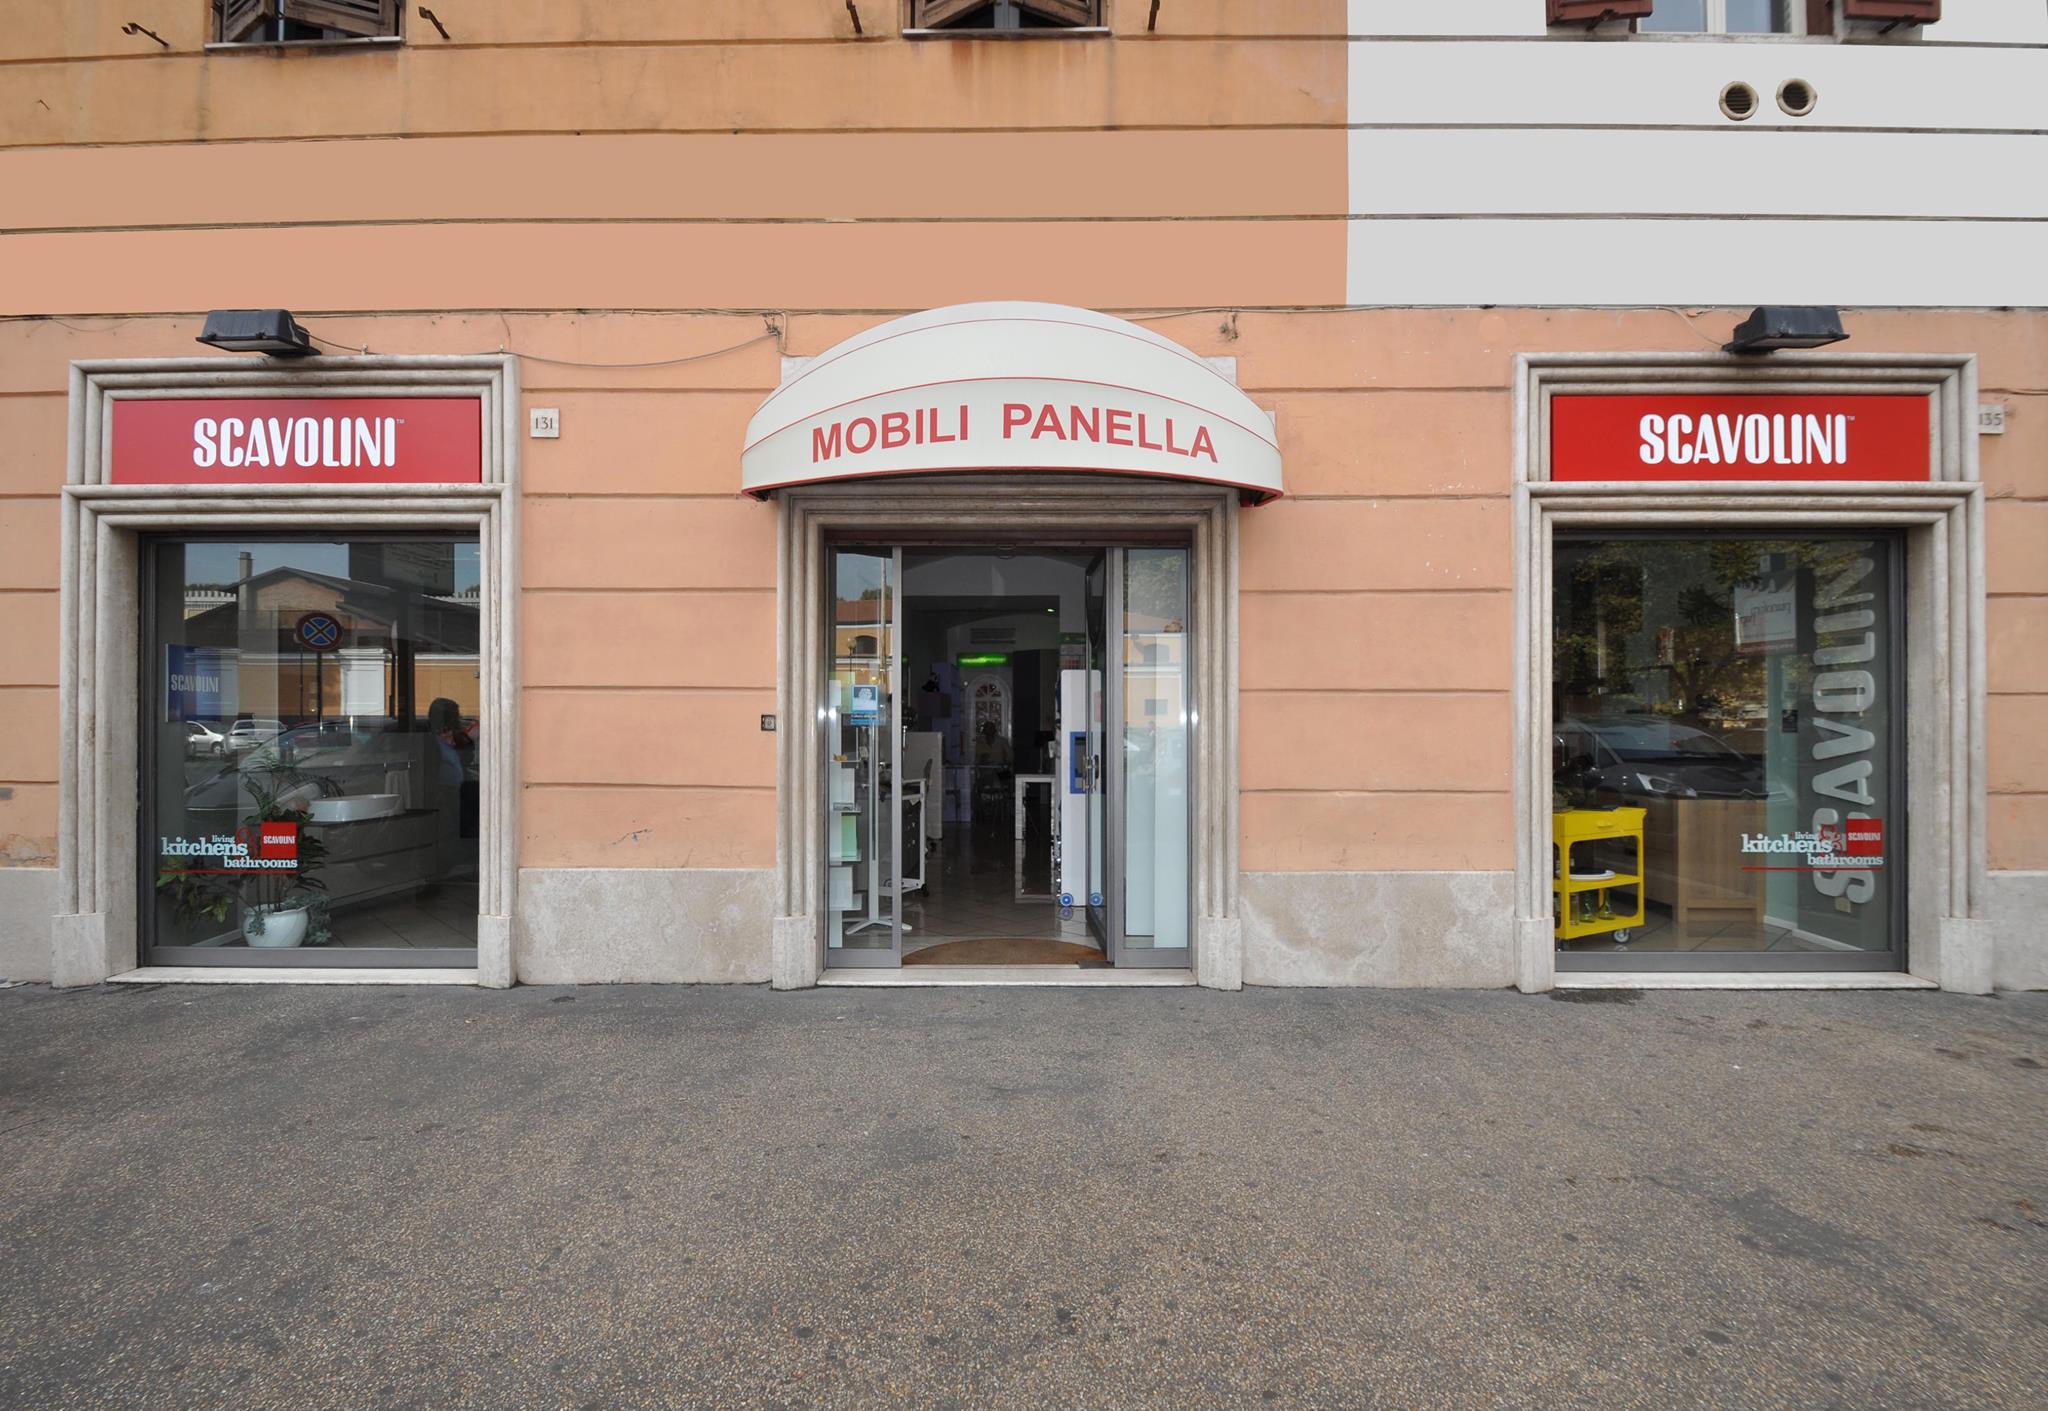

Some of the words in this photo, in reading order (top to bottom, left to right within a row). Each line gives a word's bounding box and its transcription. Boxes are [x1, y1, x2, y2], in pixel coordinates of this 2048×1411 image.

[535, 416, 553, 430] 131
[193, 417, 396, 467] SCAVOLINI
[812, 404, 968, 463] MOBILI
[1003, 403, 1218, 463] PANELLA
[1639, 413, 1847, 464] SCAVOLINI
[171, 673, 219, 693] SCAVOLINI
[161, 837, 249, 856] kitchens
[212, 835, 236, 844] living
[1741, 833, 1833, 853] kitchens
[224, 856, 298, 868] bathrooms
[1807, 852, 1884, 866] bathrooms
